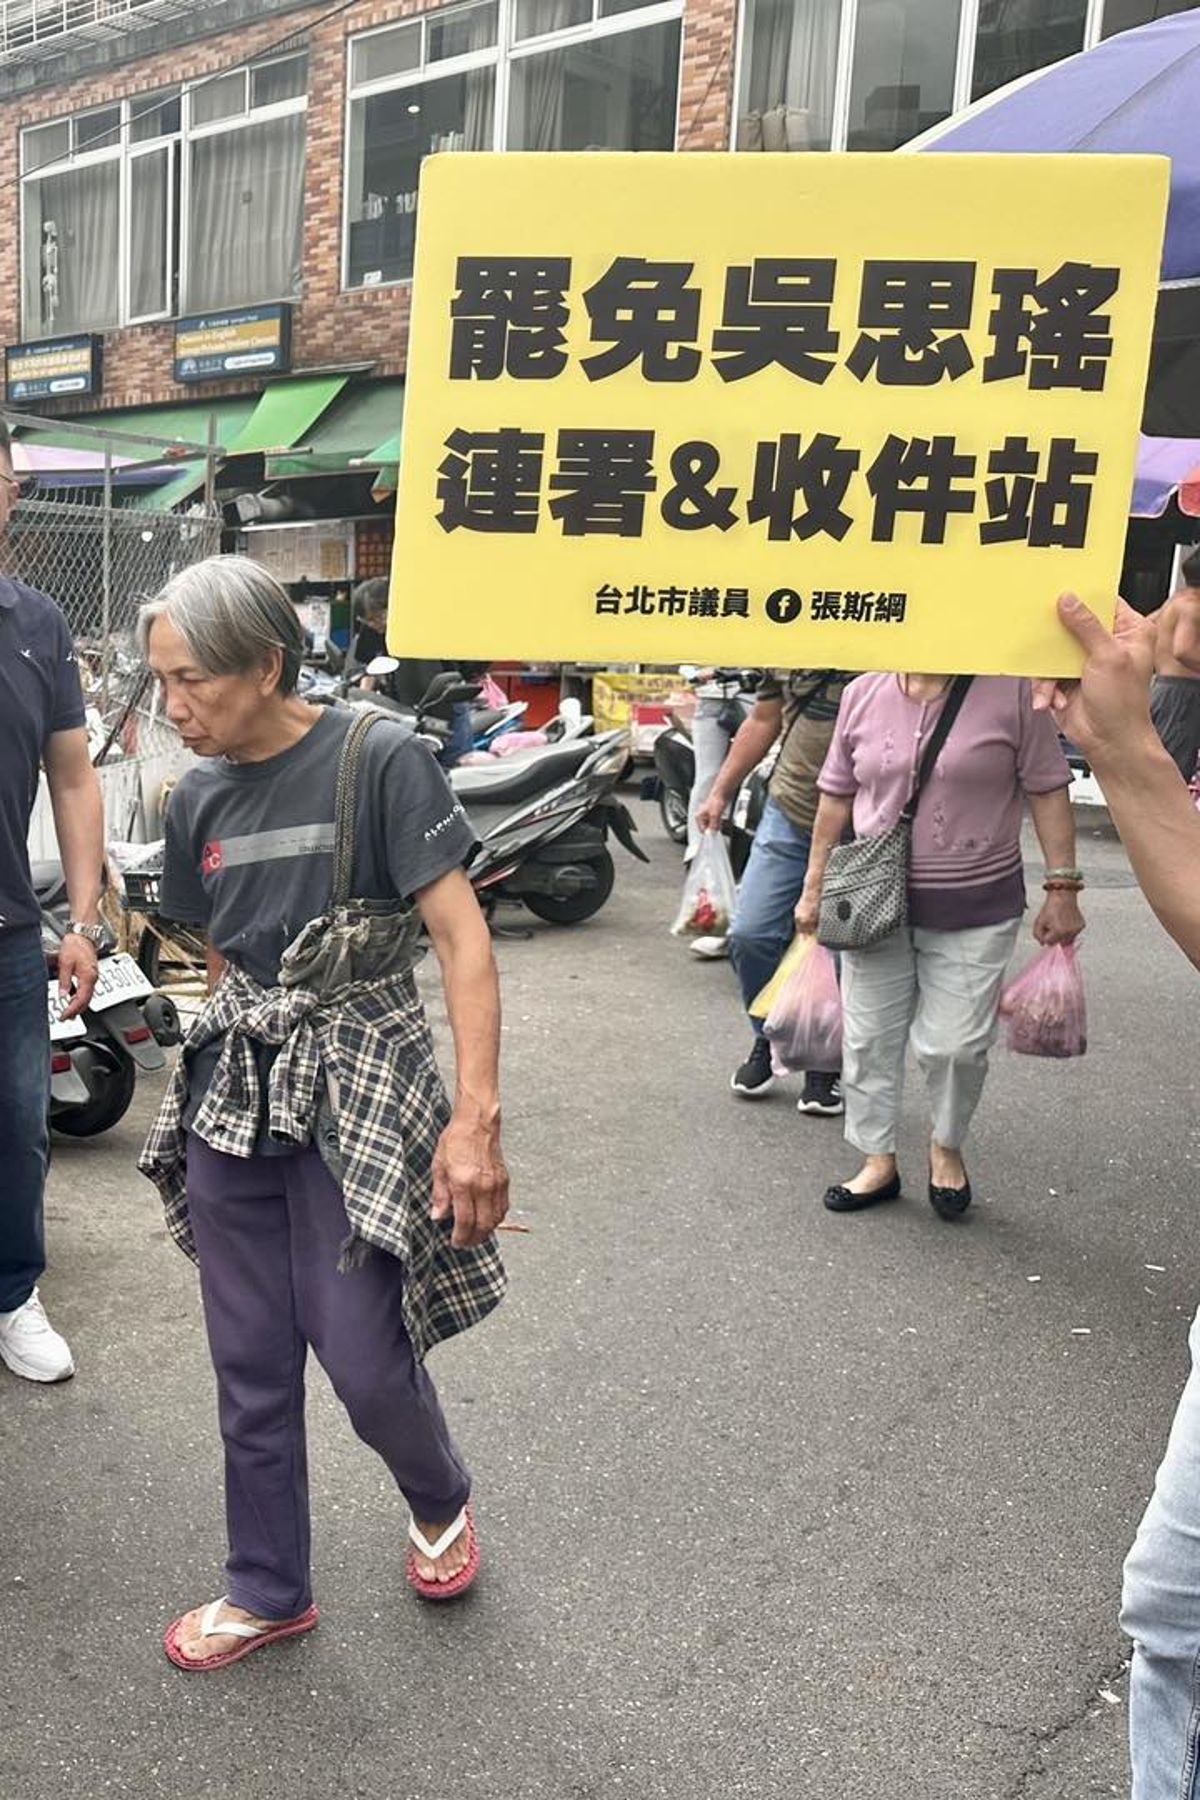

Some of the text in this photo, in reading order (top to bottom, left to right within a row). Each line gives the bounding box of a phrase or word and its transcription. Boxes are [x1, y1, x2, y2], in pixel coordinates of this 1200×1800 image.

[450, 257, 1120, 391] 罷免吳思瑤
[435, 428, 1098, 548] 連署&收件站
[594, 585, 751, 619] 台北市議員
[810, 591, 907, 624] 張斯綱
